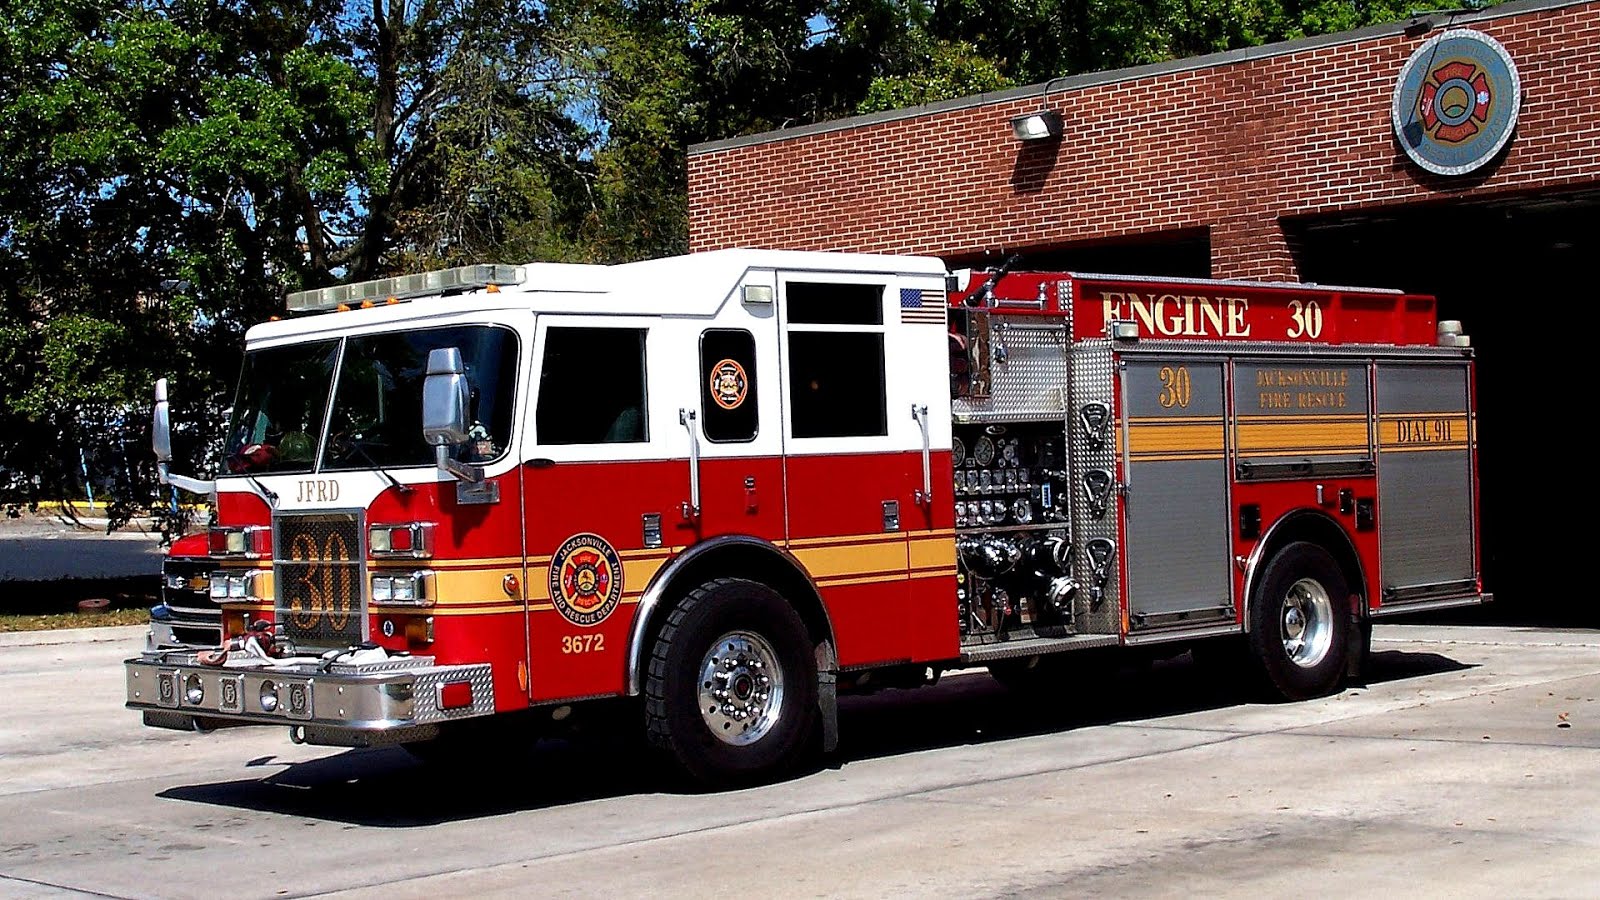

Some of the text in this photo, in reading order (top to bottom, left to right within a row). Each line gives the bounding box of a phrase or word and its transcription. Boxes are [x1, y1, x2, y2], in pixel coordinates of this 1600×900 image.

[1100, 291, 1323, 339] ENGINE 30
[1159, 366, 1191, 408] 30
[1256, 368, 1348, 387] JACKSONVILLE
[1258, 392, 1346, 409] FIRE RESCUE
[1397, 419, 1451, 442] DIAL 911
[297, 479, 340, 503] JFRD
[560, 537, 612, 560] JACKSONVILLE
[290, 530, 351, 631] 30
[551, 565, 560, 588] FIRE
[553, 590, 565, 609] AND
[597, 562, 620, 619] DEPARTMENT
[564, 607, 596, 623] RESCUE
[561, 633, 605, 654] 3672
